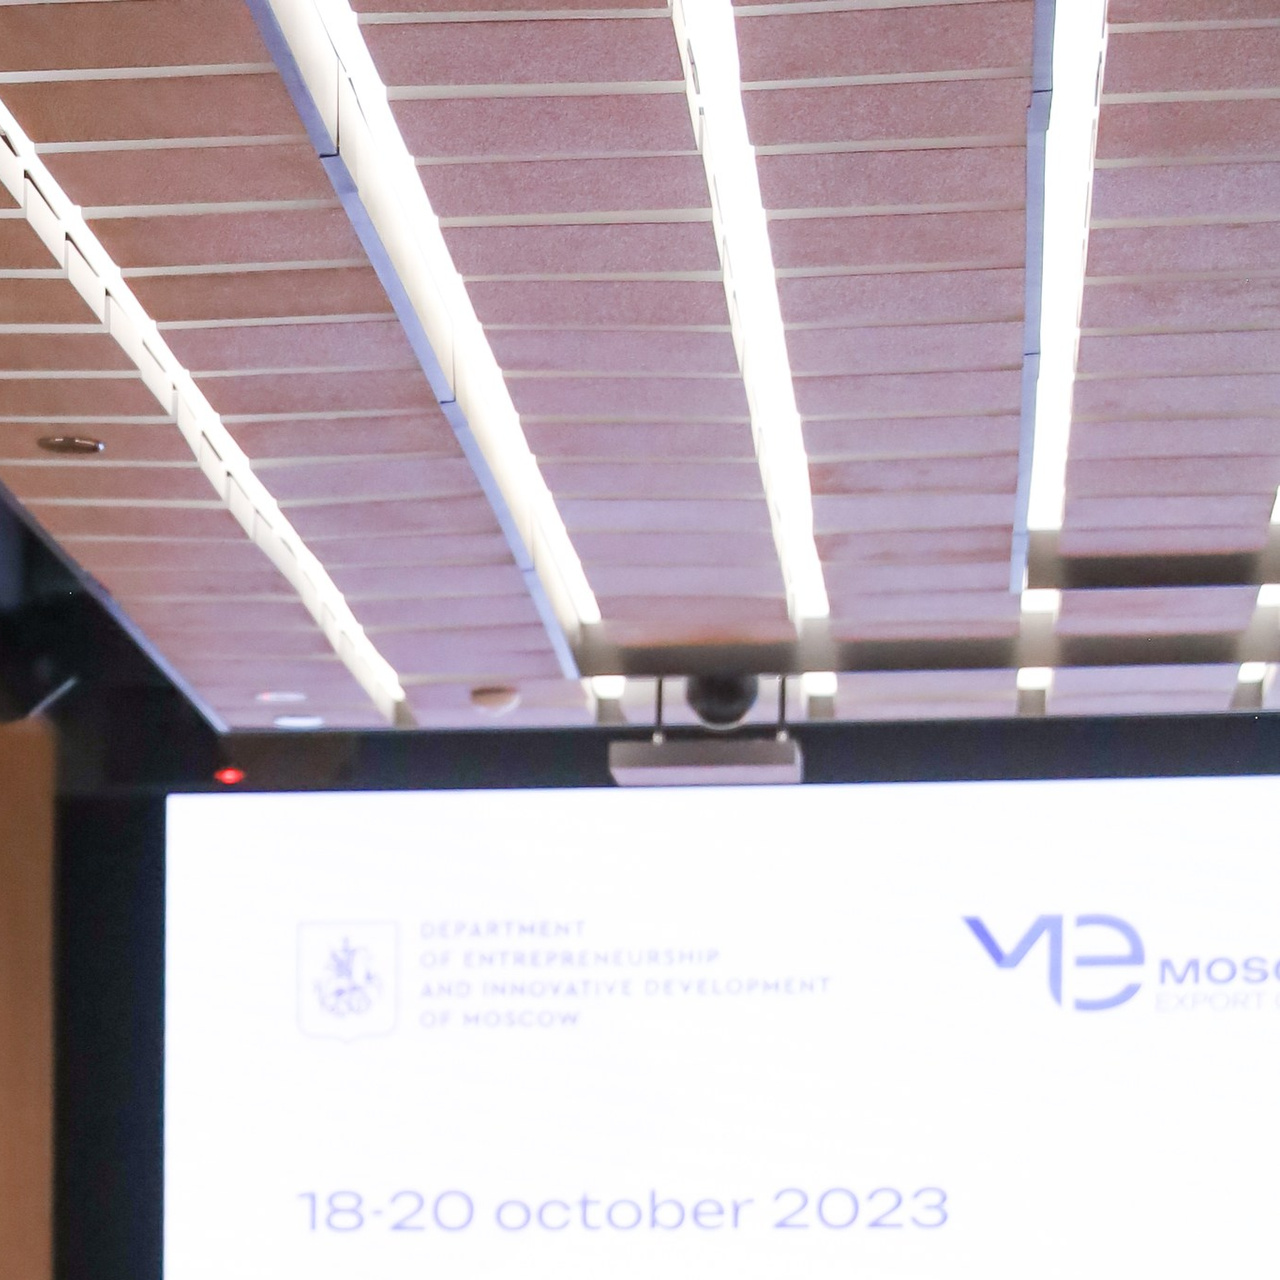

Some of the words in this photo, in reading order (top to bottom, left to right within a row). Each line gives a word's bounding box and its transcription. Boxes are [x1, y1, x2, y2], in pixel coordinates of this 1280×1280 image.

[420, 920, 586, 939] DEPARTMENT
[420, 949, 450, 968] OF
[463, 948, 721, 968] ENTREPRENEURSHIP
[1158, 955, 1280, 985] MOS
[420, 979, 472, 998] AND
[482, 977, 632, 998] INNOVATIVE
[645, 975, 832, 997] DEVELOPMENT
[1155, 990, 1265, 1013] EXPORT
[420, 1010, 450, 1029] OF
[462, 1010, 581, 1029] MOSCOW
[297, 1190, 476, 1233] 18-20
[494, 1189, 754, 1231] october
[772, 1186, 950, 1230] 2023
